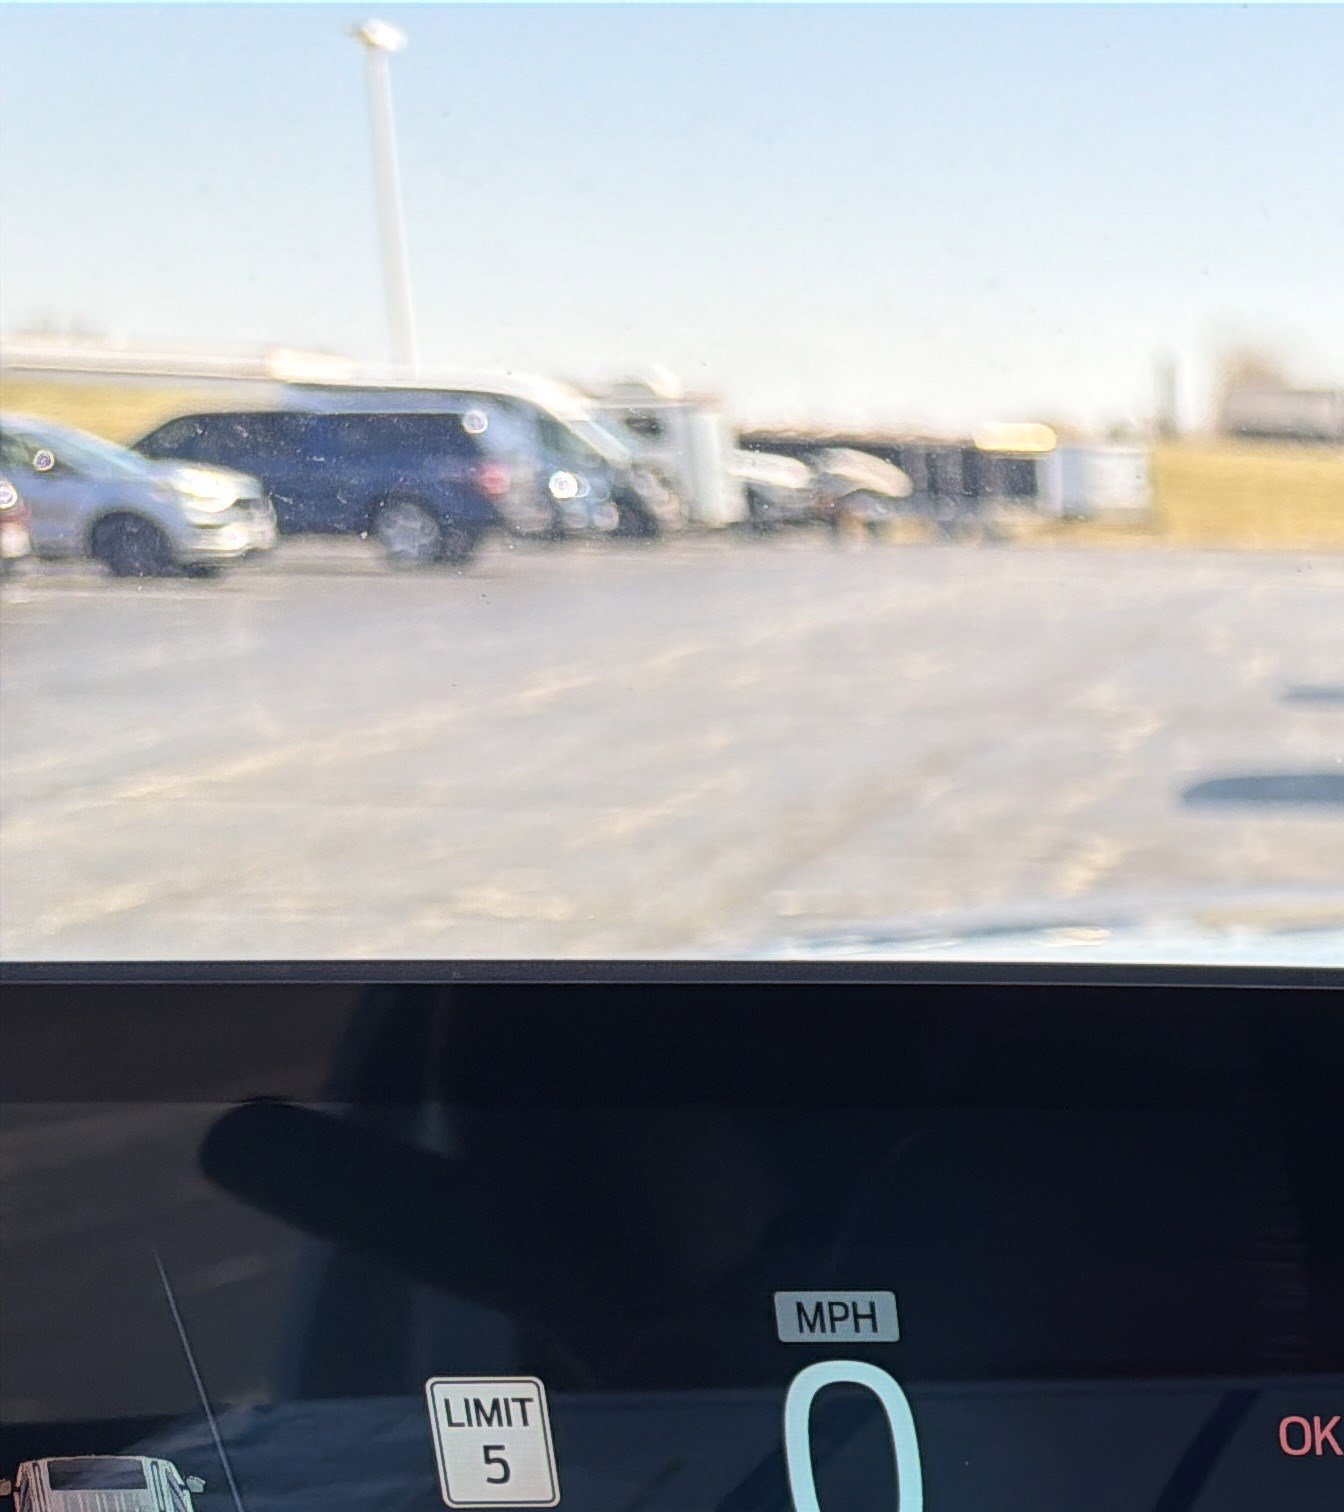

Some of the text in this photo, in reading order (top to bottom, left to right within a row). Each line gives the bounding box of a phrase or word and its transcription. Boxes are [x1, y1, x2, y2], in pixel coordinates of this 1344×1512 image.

[795, 1300, 879, 1335] MPH
[442, 1396, 534, 1429] LIMIT
[1280, 1416, 1342, 1455] OK
[482, 1444, 510, 1485] 5
